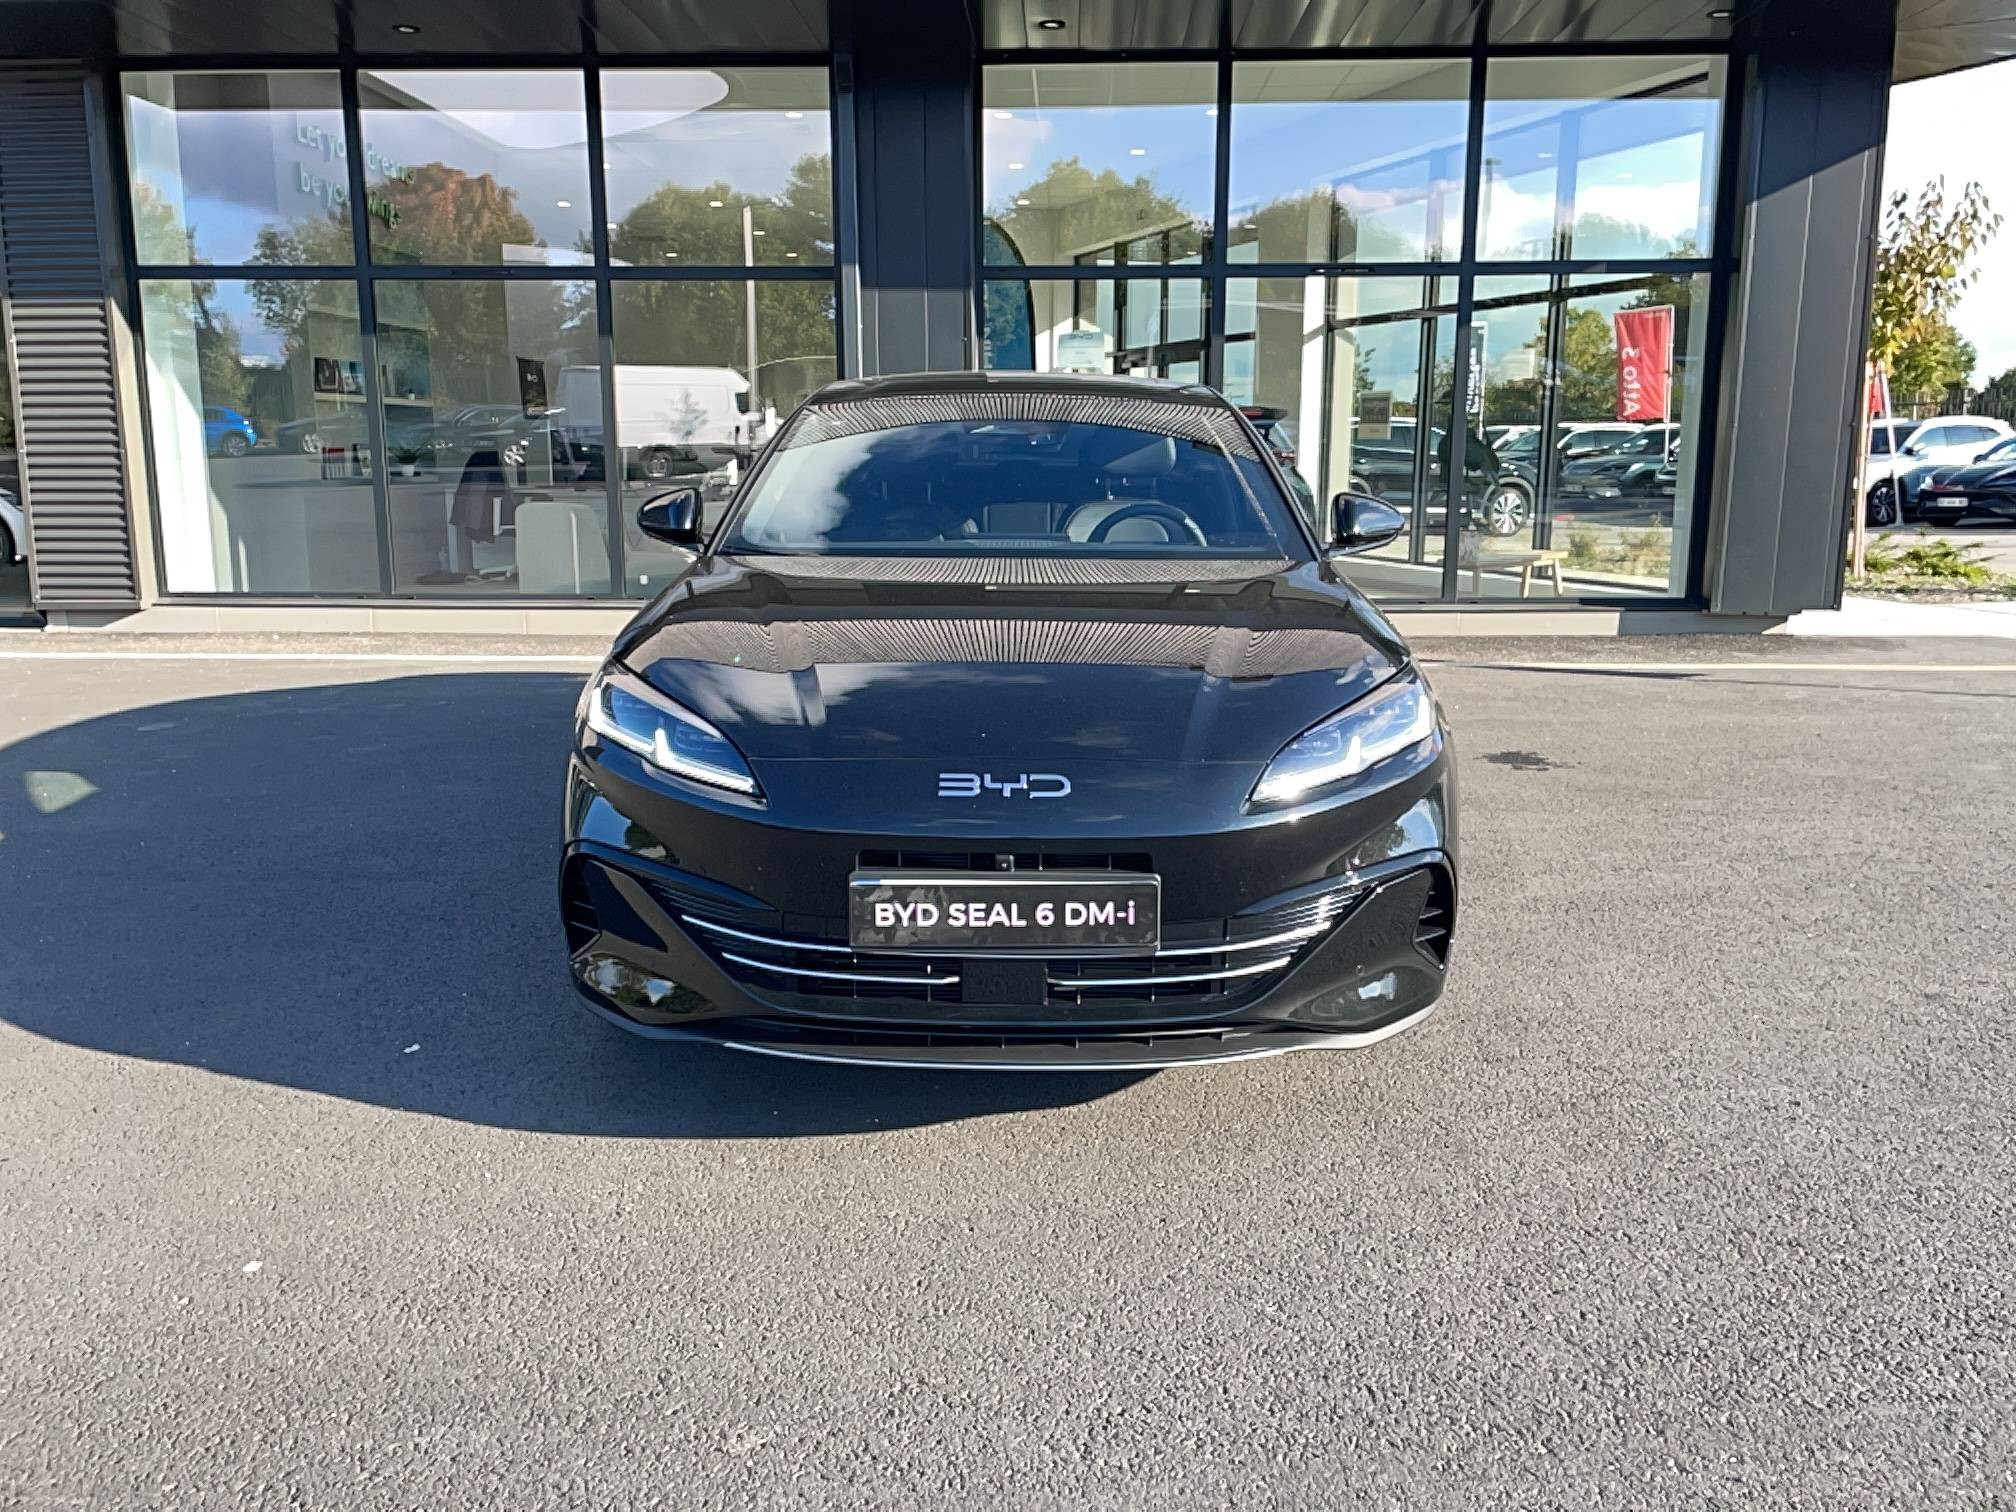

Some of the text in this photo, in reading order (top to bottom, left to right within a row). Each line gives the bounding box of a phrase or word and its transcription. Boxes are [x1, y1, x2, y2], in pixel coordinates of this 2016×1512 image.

[300, 162, 321, 196] be
[938, 772, 1072, 799] BYD
[874, 900, 1136, 928] BYD SEAL 6 DM-i
